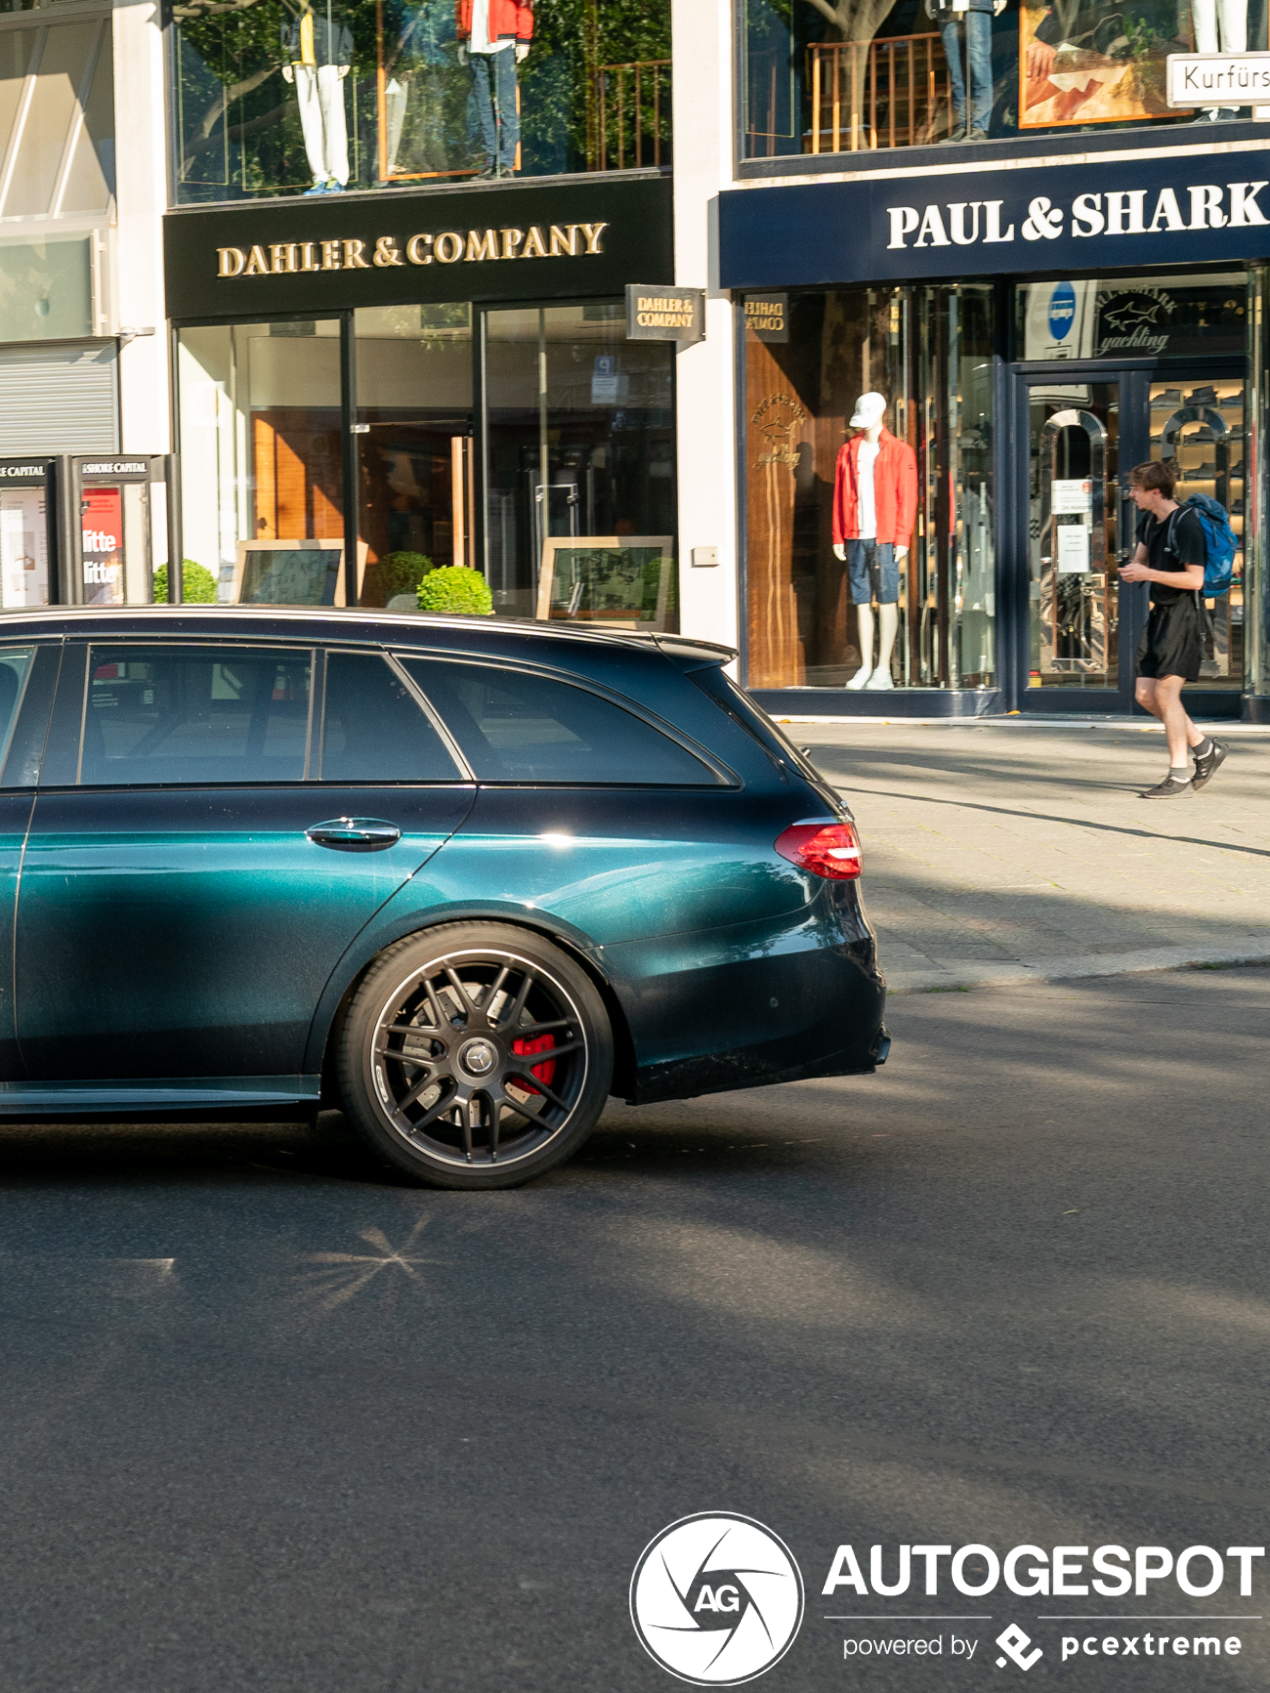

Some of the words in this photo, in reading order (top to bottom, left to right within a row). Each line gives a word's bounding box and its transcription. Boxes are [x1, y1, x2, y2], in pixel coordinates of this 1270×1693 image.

[886, 200, 1015, 250] PAUL
[1021, 196, 1065, 241] &
[1071, 180, 1270, 238] SHARK
[216, 239, 371, 277] DAHLER
[372, 235, 406, 268] &
[406, 223, 608, 264] COMPANY
[637, 297, 682, 313] DAHLER
[683, 299, 694, 313] &
[636, 313, 694, 328] COMPANY
[1093, 325, 1170, 356] yachting
[7, 465, 46, 477] CAPITAL
[113, 462, 148, 473] CAPITAL
